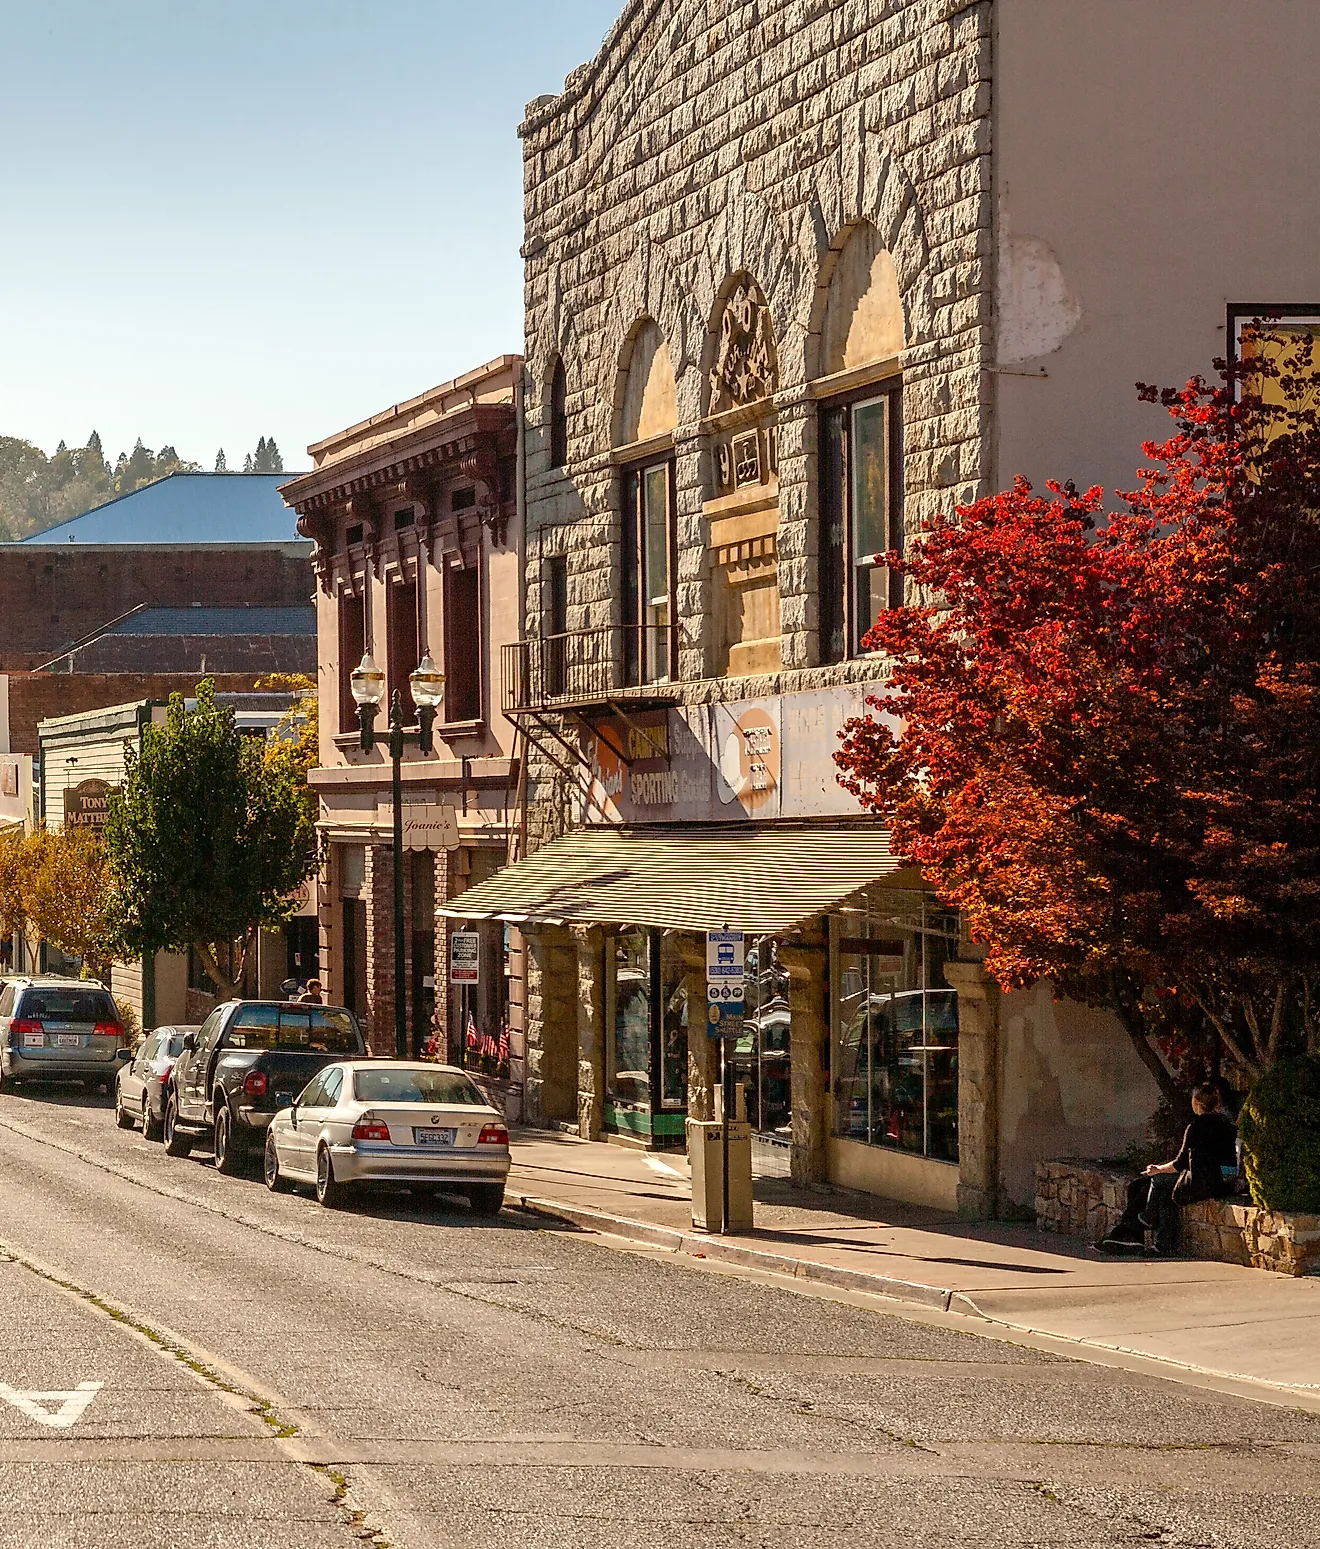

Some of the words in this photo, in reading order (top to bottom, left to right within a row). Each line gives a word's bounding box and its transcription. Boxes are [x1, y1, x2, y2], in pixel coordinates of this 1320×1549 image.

[631, 770, 679, 805] SPORTING
[80, 796, 108, 809] TONY
[67, 811, 110, 825] MATTHE
[402, 820, 450, 832] Joanie's
